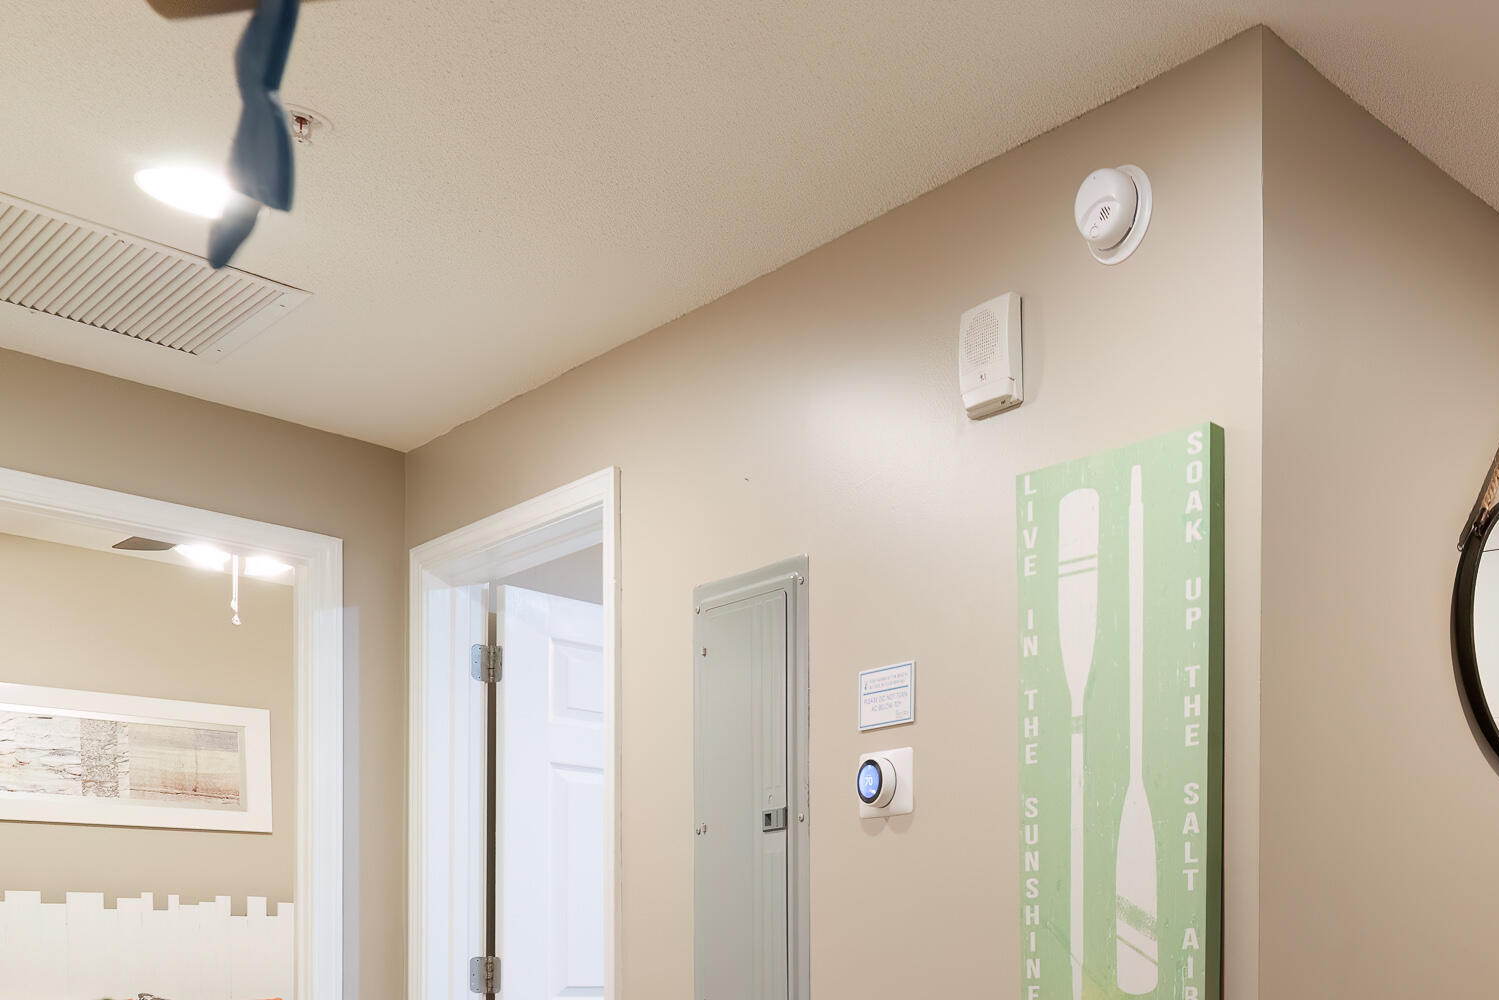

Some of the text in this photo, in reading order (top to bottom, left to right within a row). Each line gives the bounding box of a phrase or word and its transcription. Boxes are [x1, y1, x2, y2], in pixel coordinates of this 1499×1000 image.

[1023, 475, 1039, 576] LIVE
[1185, 431, 1203, 543] SOAK
[1023, 609, 1038, 657] IN
[1185, 577, 1202, 630] UP
[1024, 689, 1039, 764] THE
[1184, 665, 1201, 747] THE
[1183, 782, 1200, 891] SALT
